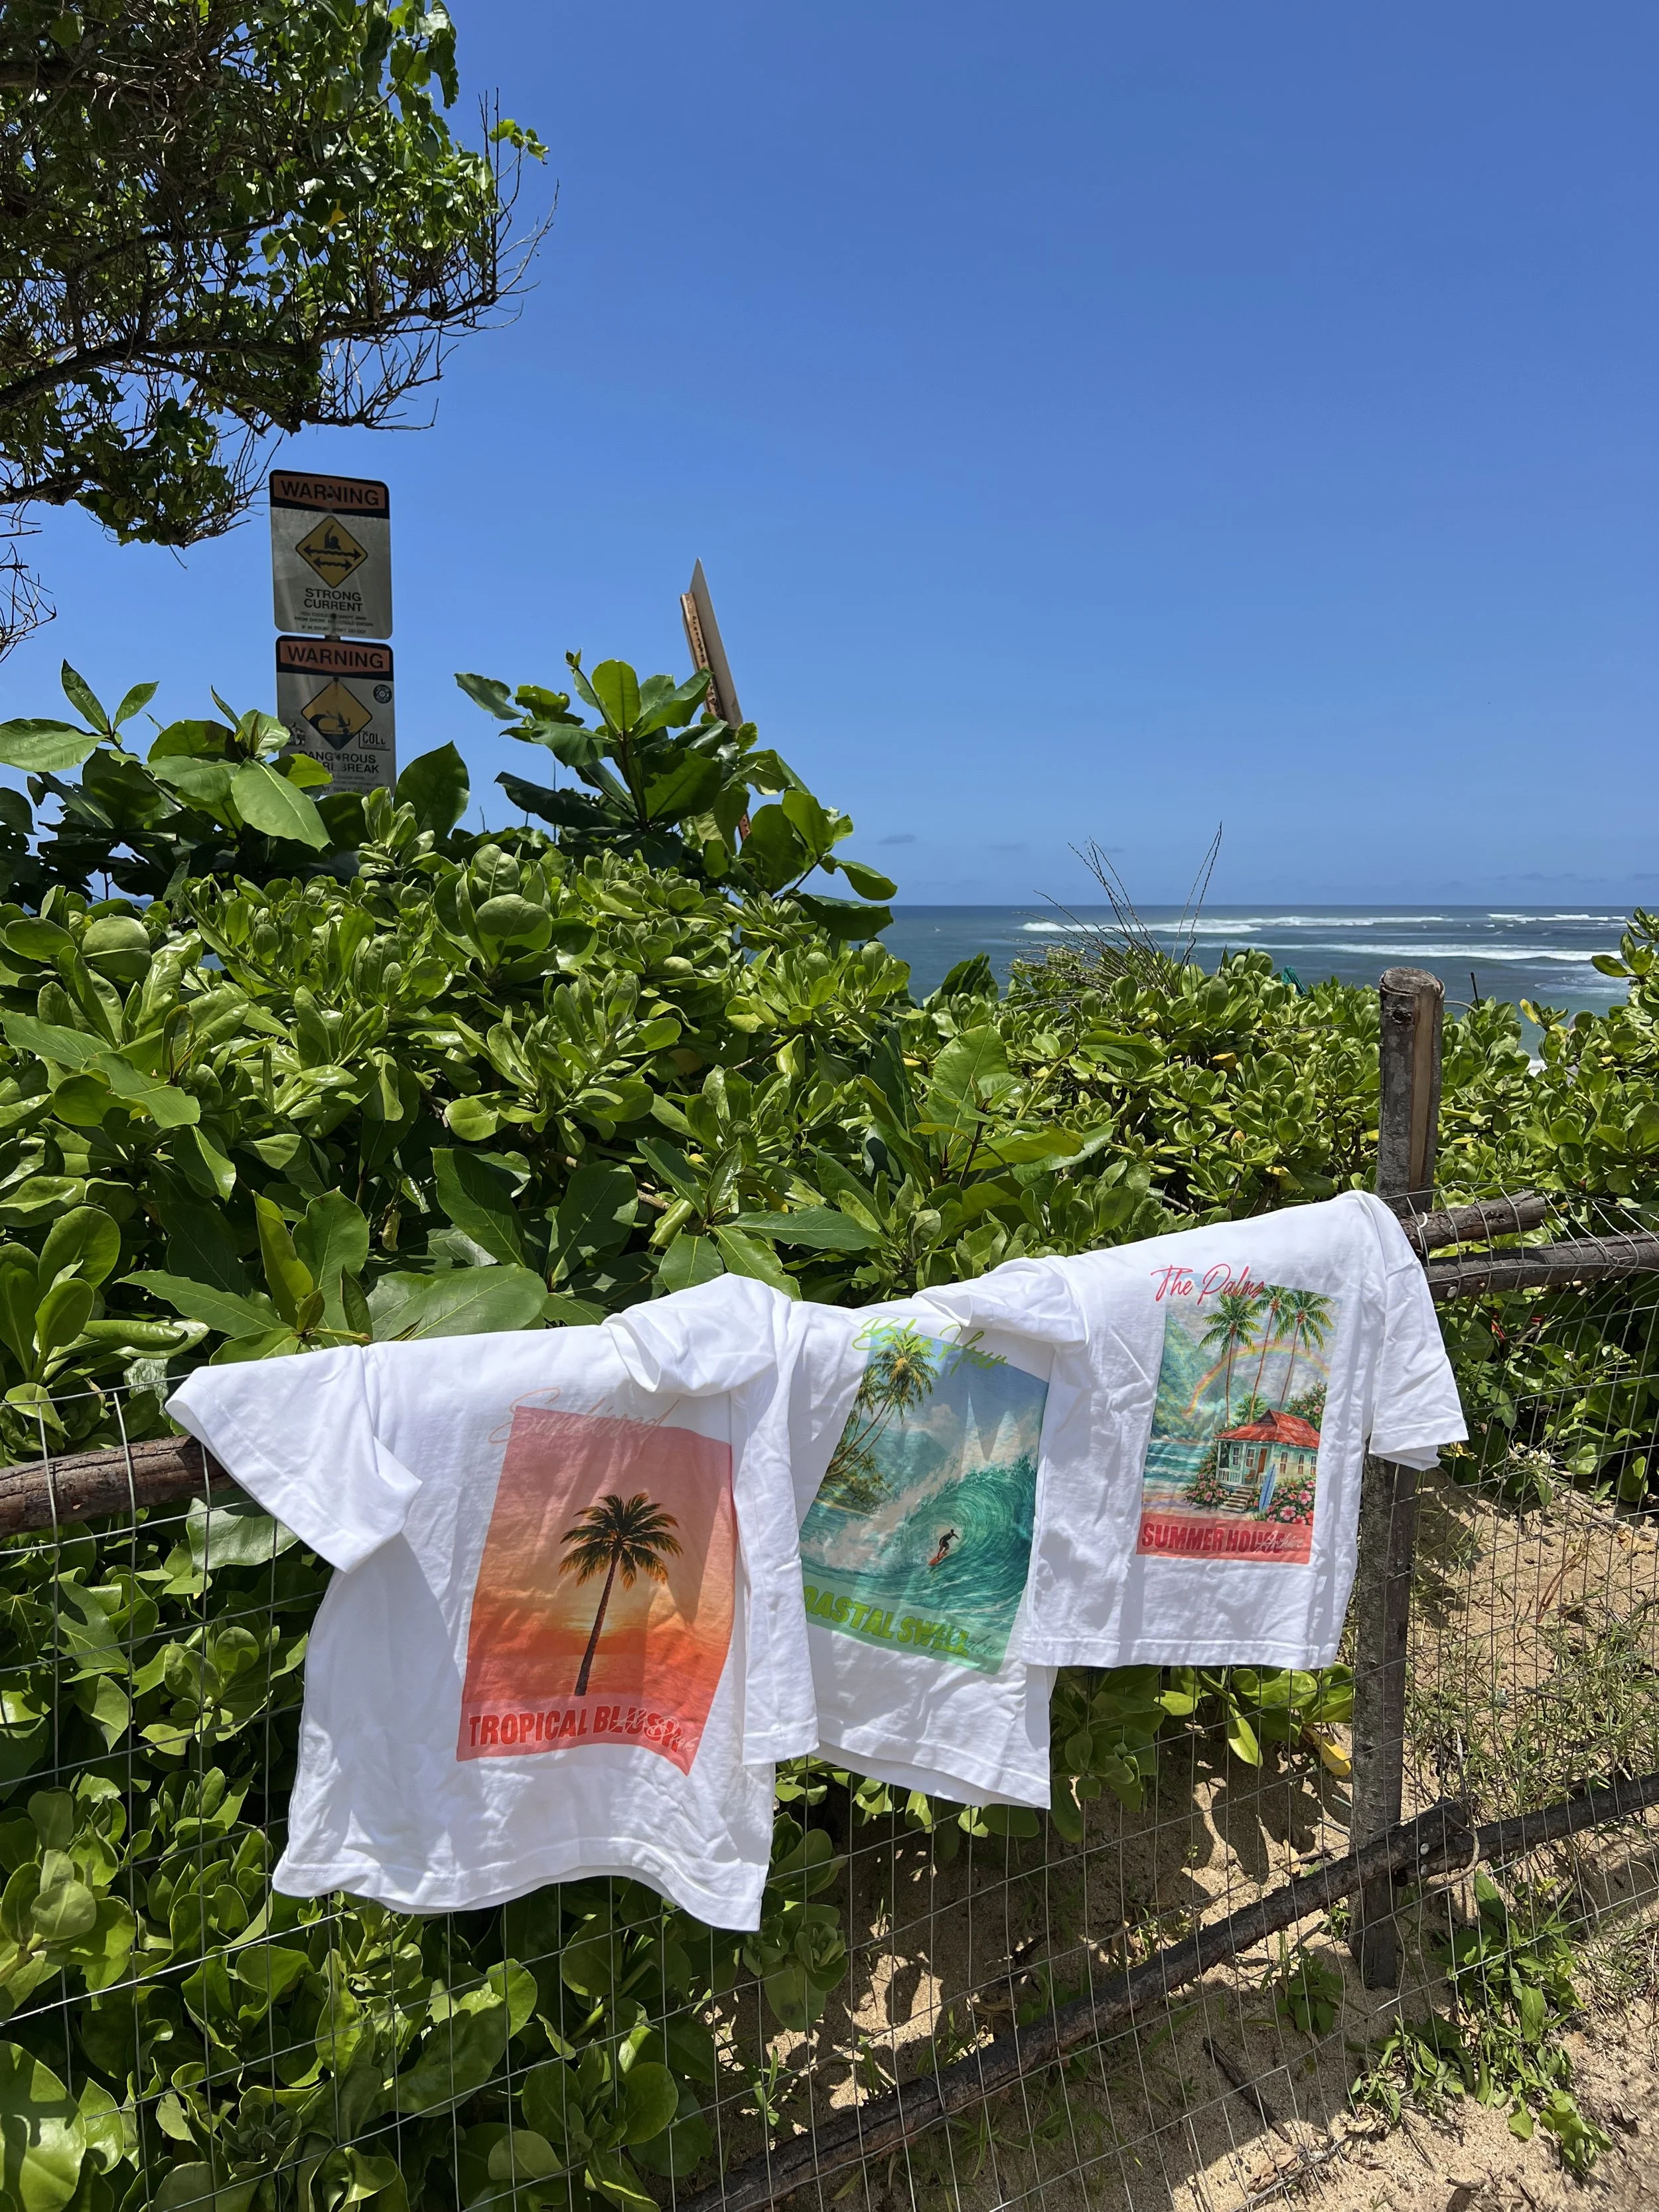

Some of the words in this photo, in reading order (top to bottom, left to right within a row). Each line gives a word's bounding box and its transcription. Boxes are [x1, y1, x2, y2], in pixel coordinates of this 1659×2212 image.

[281, 480, 380, 506] WARNING
[303, 599, 363, 612] CURRENT
[305, 587, 362, 602] STRONG
[287, 646, 384, 669] WARNING
[299, 750, 376, 764] ANGROUS
[1149, 1264, 1194, 1302] The
[1196, 1263, 1265, 1306] Palms
[1141, 1522, 1225, 1552] SUMMER
[1226, 1528, 1285, 1554] HOUSE
[804, 1585, 895, 1639] OASTAL
[469, 1708, 589, 1747] TROPICAL
[592, 1705, 683, 1753] BLUSH
